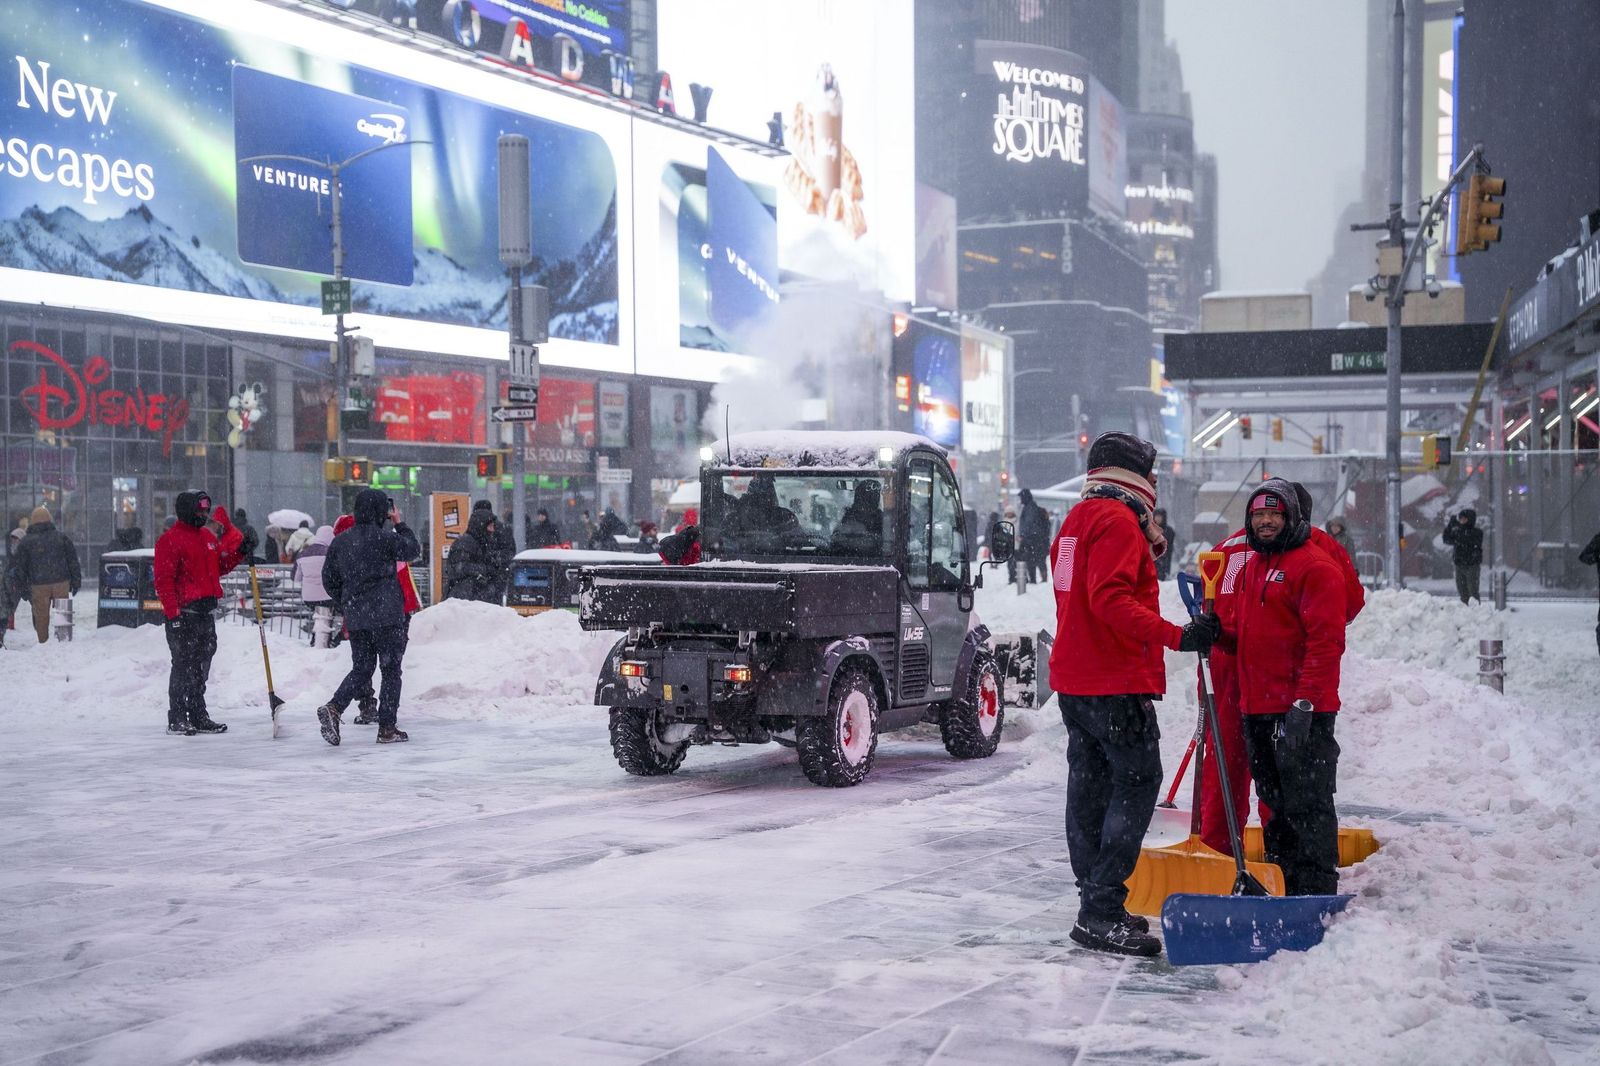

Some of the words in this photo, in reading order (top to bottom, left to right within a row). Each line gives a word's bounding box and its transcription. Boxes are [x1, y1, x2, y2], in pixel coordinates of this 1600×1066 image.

[15, 54, 118, 126] New
[992, 60, 1072, 92] WELCOME
[1039, 96, 1084, 130] TIMES
[992, 117, 1087, 166] SQUARE
[0, 137, 155, 205] scapes
[252, 164, 330, 195] VENTURE
[1509, 295, 1538, 351] SEPHORA
[1344, 355, 1354, 368] W
[1359, 354, 1373, 368] 46
